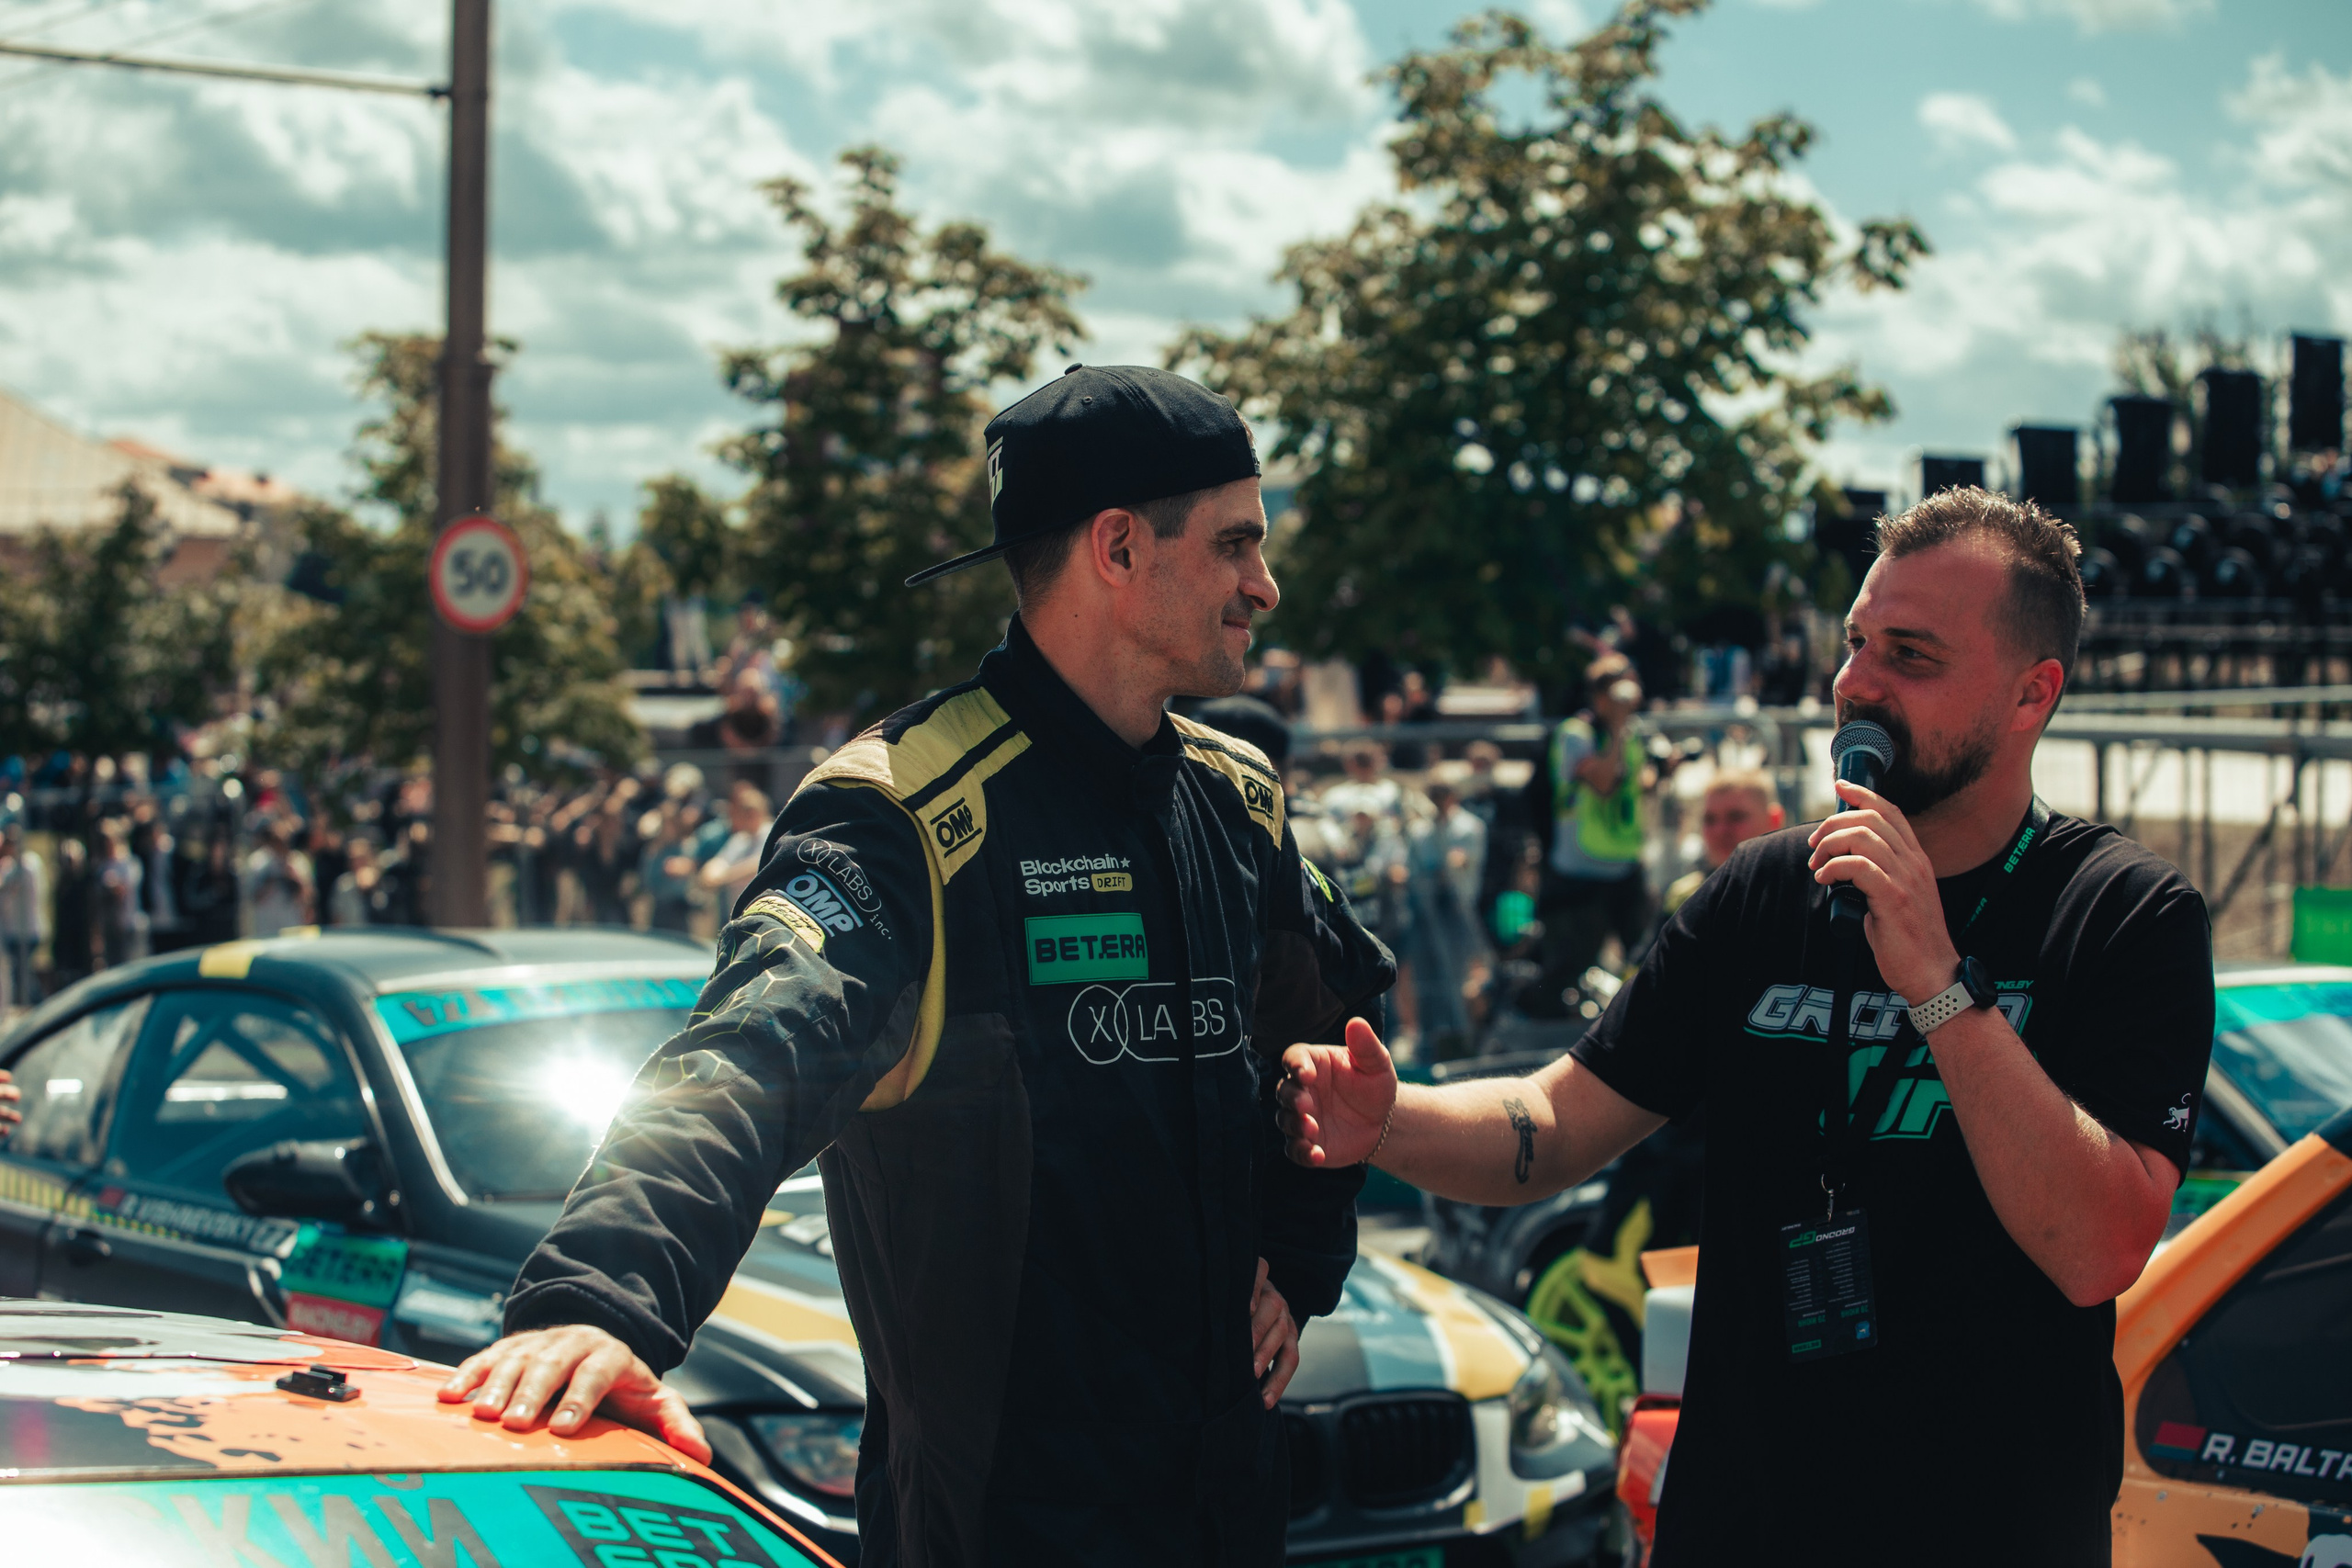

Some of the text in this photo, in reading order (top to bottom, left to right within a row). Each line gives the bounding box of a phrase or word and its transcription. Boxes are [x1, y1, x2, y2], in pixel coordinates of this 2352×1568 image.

[450, 548, 510, 599] 50
[936, 805, 975, 848] OMP
[1020, 853, 1120, 876] Blockchain
[1024, 874, 1126, 897] Sports DRIFT
[786, 874, 854, 933] OMP
[828, 856, 873, 901] LABS
[869, 914, 892, 940] inc.
[1088, 998, 1227, 1043] X LABS
[1788, 1226, 1856, 1249] GRODNO GP
[557, 1499, 737, 1557] BET
